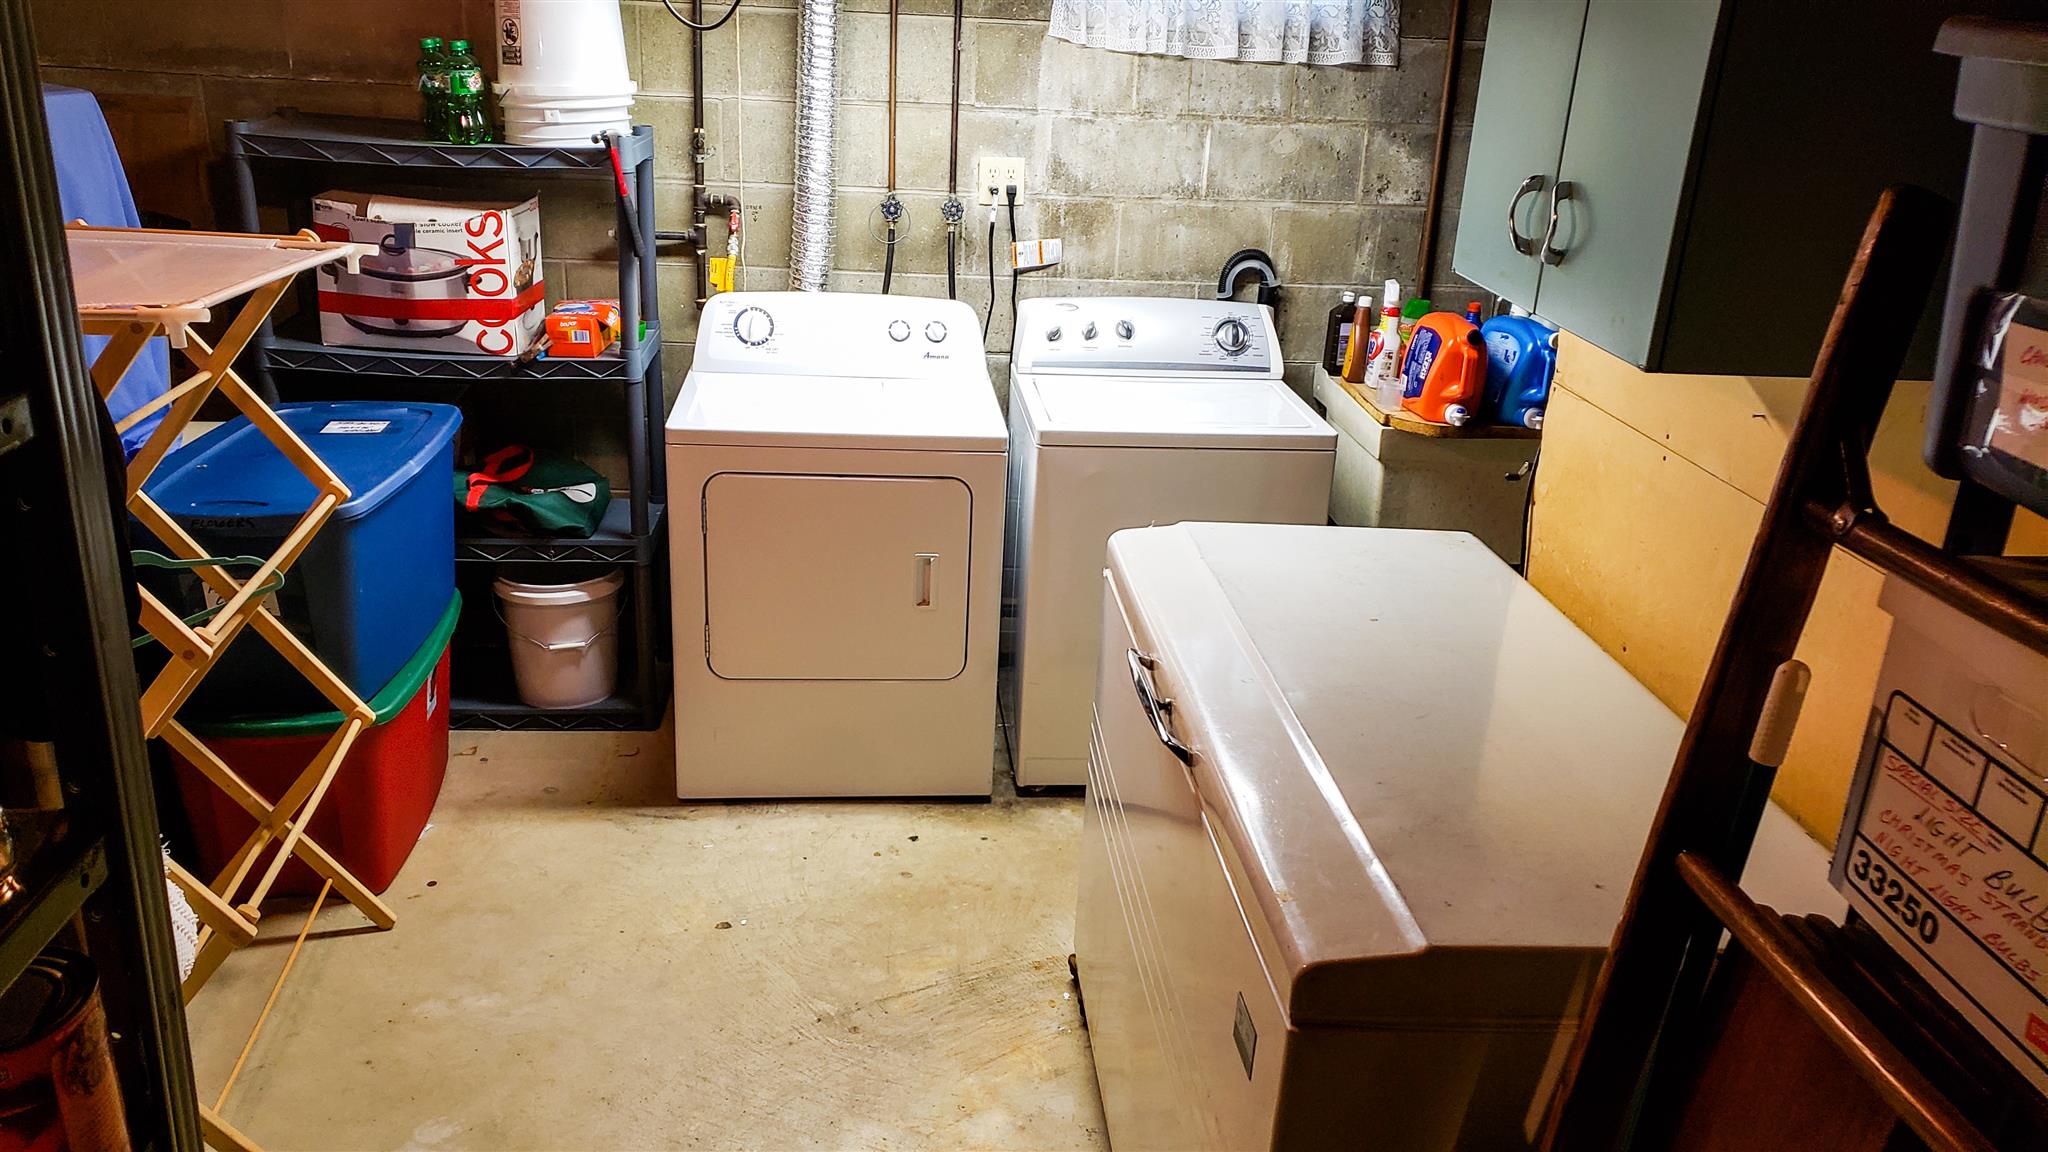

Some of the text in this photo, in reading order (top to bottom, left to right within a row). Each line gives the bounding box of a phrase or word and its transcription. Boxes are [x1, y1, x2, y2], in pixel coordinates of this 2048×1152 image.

[922, 351, 950, 360] Amana
[191, 517, 256, 529] FLOWERS
[1880, 809, 1972, 887] CHRISTMAS
[1914, 807, 1986, 857] LIGHT
[1854, 849, 1940, 944] 33250
[1876, 830, 2041, 982] NIGHT LIGHT BULBS
